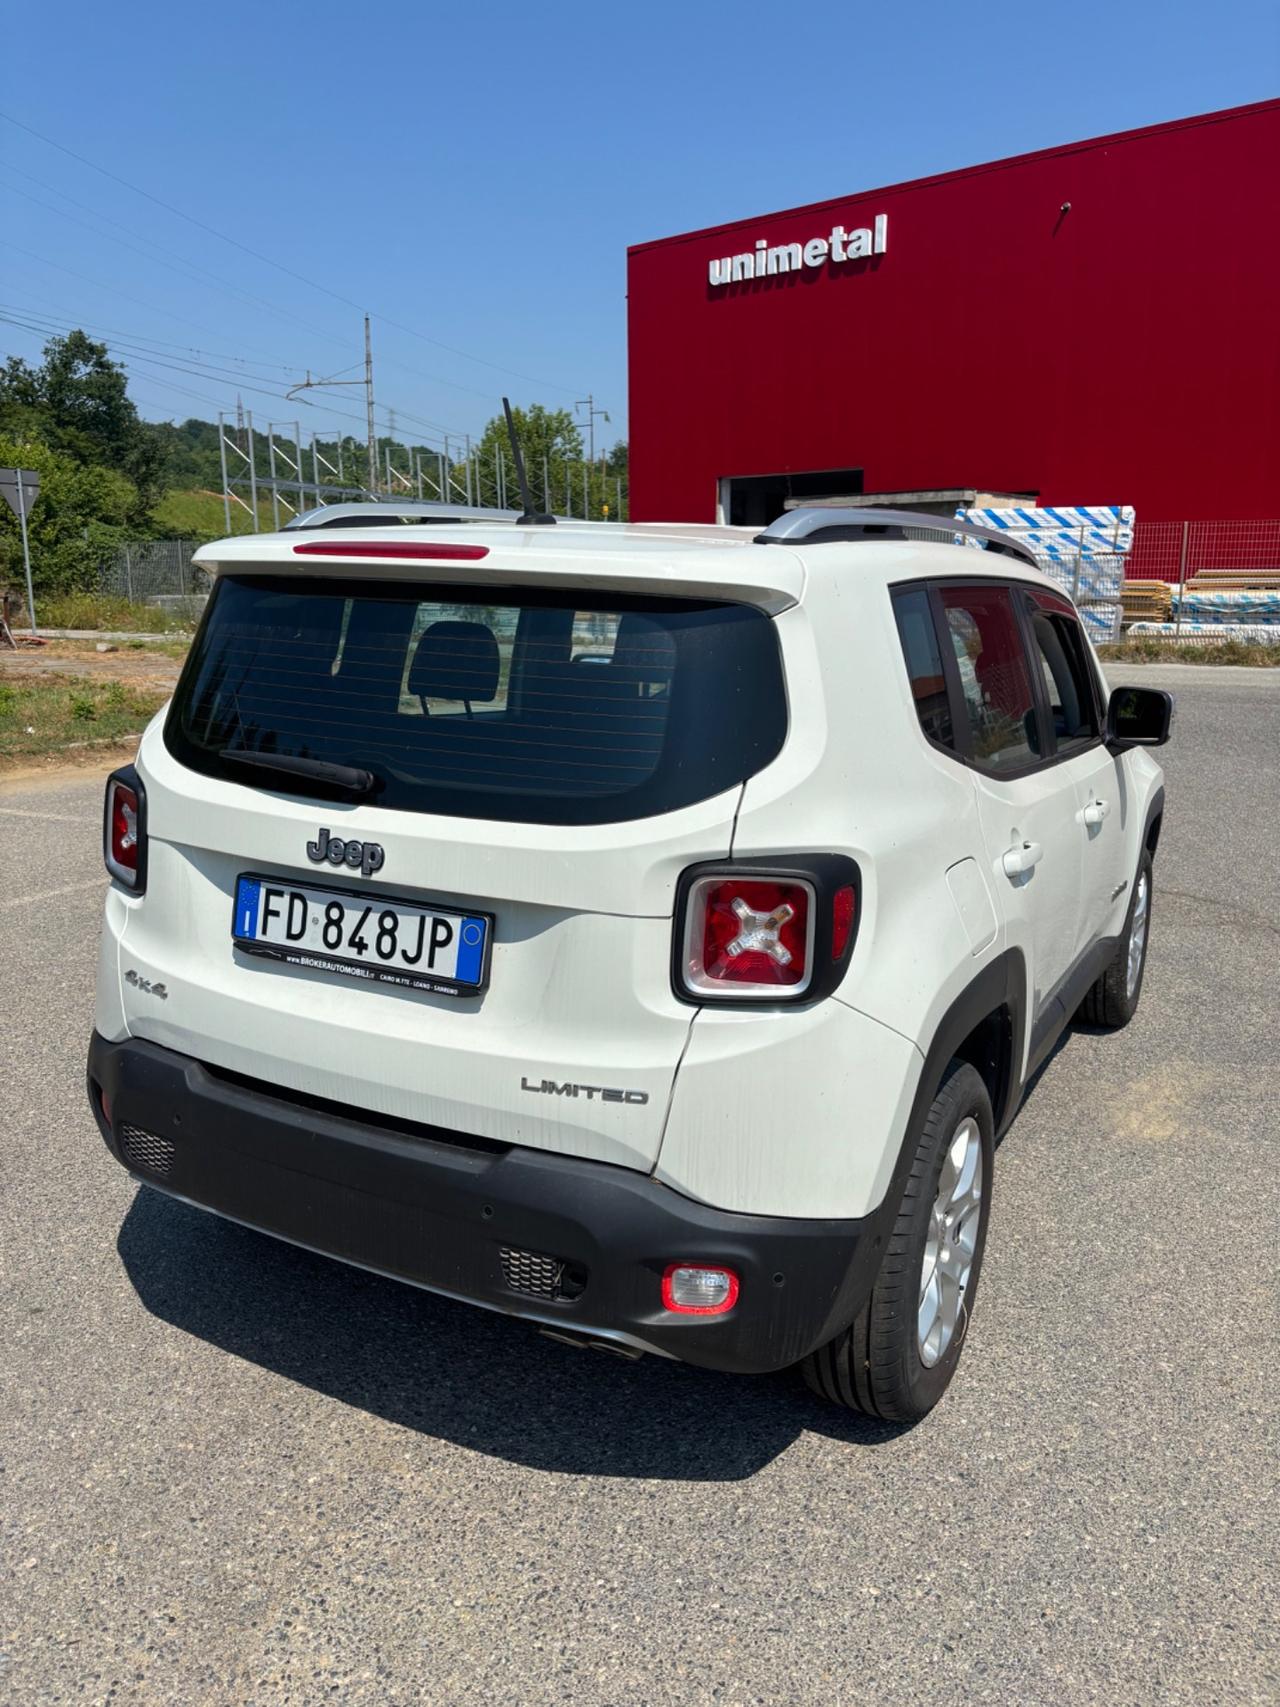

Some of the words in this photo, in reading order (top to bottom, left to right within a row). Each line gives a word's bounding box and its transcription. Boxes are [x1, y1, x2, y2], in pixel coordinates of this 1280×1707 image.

[709, 214, 888, 286] unimetal
[306, 828, 385, 876] Jeep
[261, 887, 308, 941] FD
[322, 900, 454, 969] 848JP
[521, 1076, 649, 1105] LIMITED
